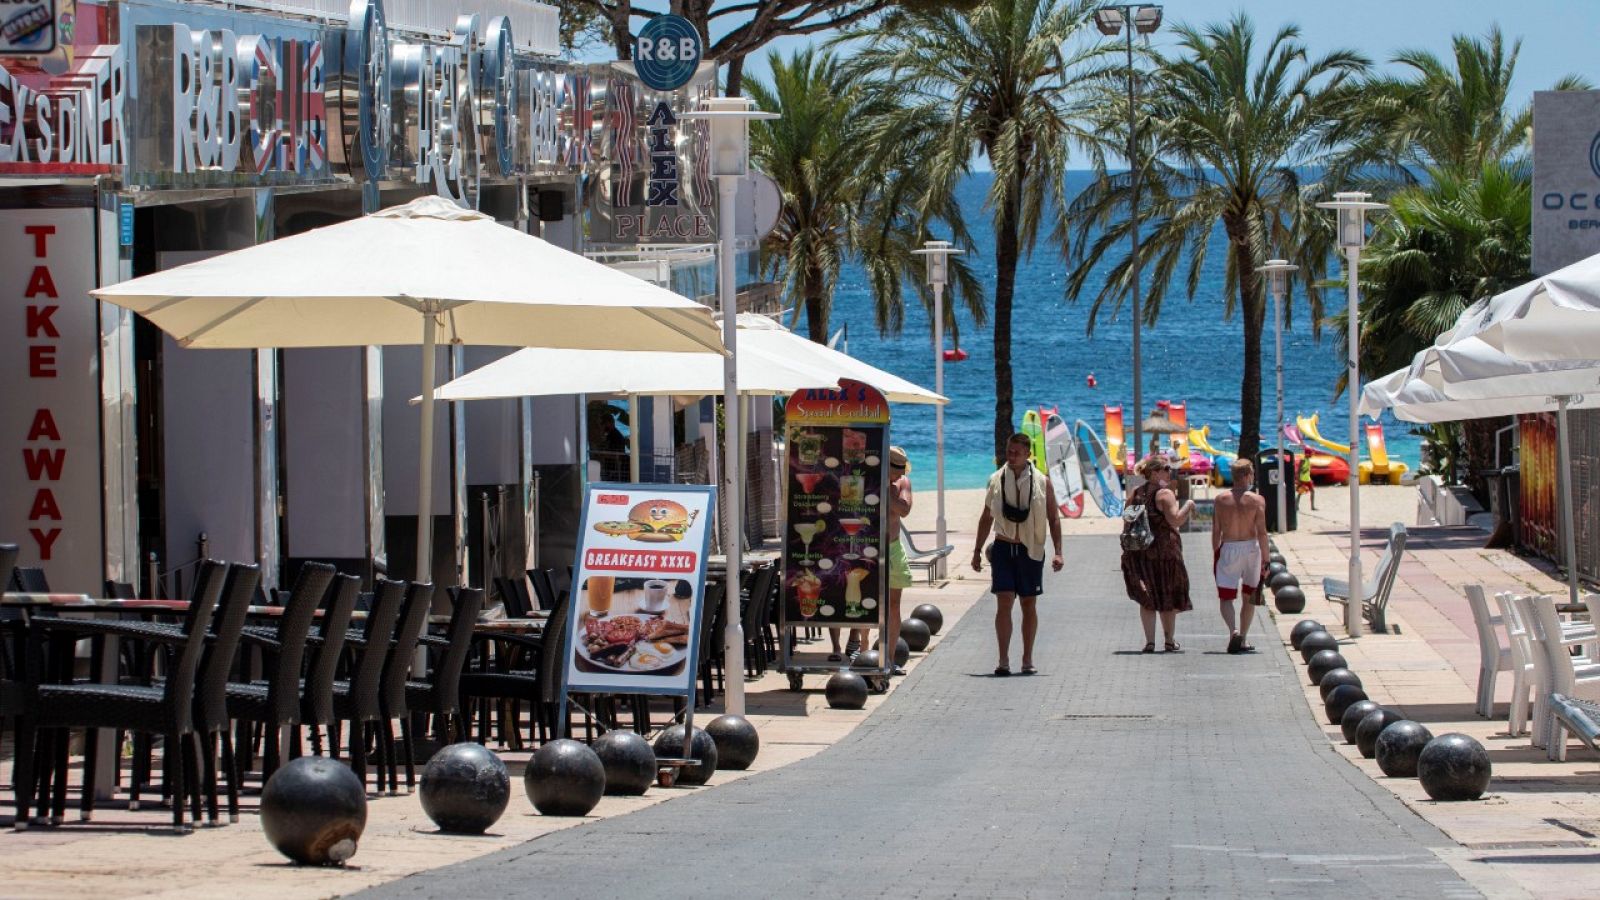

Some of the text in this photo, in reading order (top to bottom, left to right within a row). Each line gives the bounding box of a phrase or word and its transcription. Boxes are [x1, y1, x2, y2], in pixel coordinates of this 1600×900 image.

[637, 37, 697, 61] R&B
[58, 46, 128, 165] DINER
[174, 22, 241, 173] R&B
[647, 102, 679, 206] ALEX
[615, 215, 711, 238] PLACE
[1568, 220, 1600, 229] BEA
[23, 225, 66, 560] TAKE AWAY
[587, 552, 691, 568] BREAKFAST XXXL
